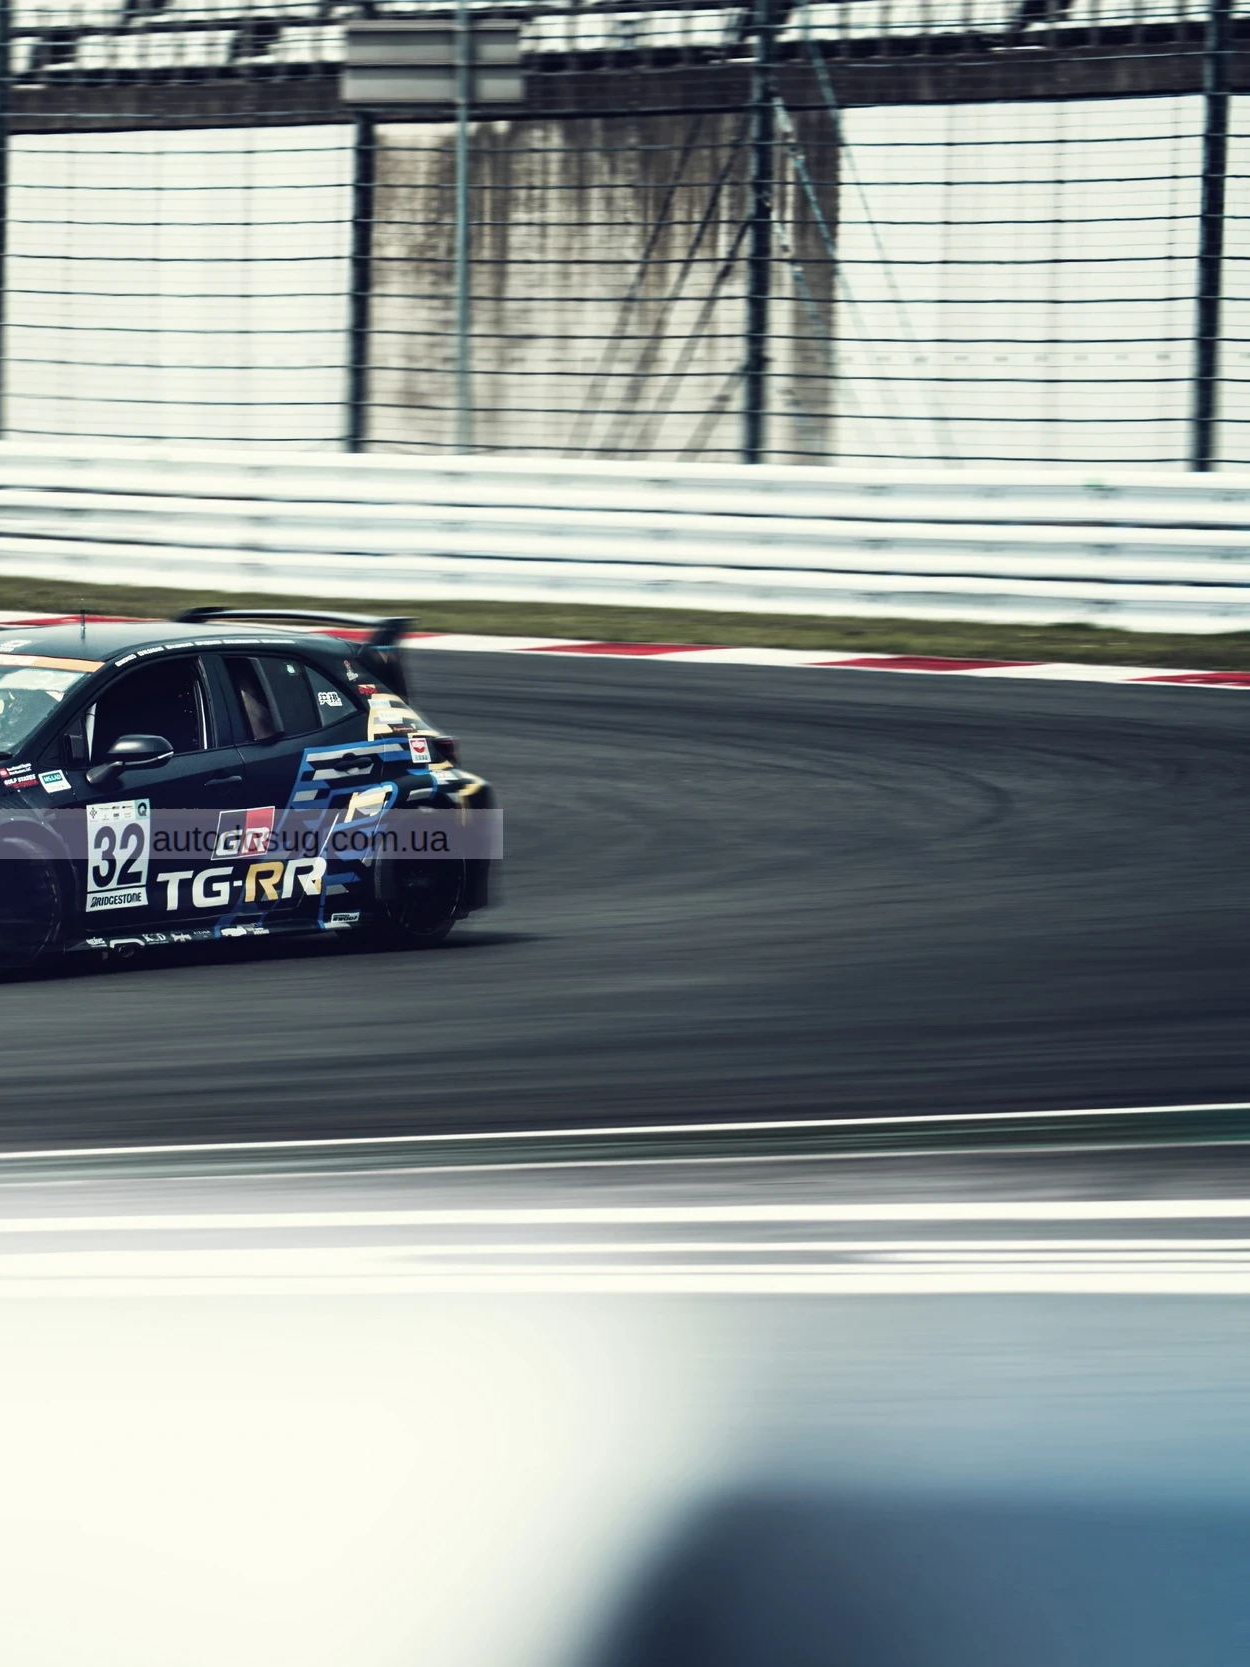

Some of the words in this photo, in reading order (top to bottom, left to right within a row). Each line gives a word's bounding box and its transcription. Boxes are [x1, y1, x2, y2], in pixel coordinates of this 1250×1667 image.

[137, 802, 147, 817] Q
[92, 823, 145, 888] 32
[215, 826, 270, 856] GR
[156, 857, 327, 912] TG-RR
[90, 892, 142, 908] BRIDGESTONE
